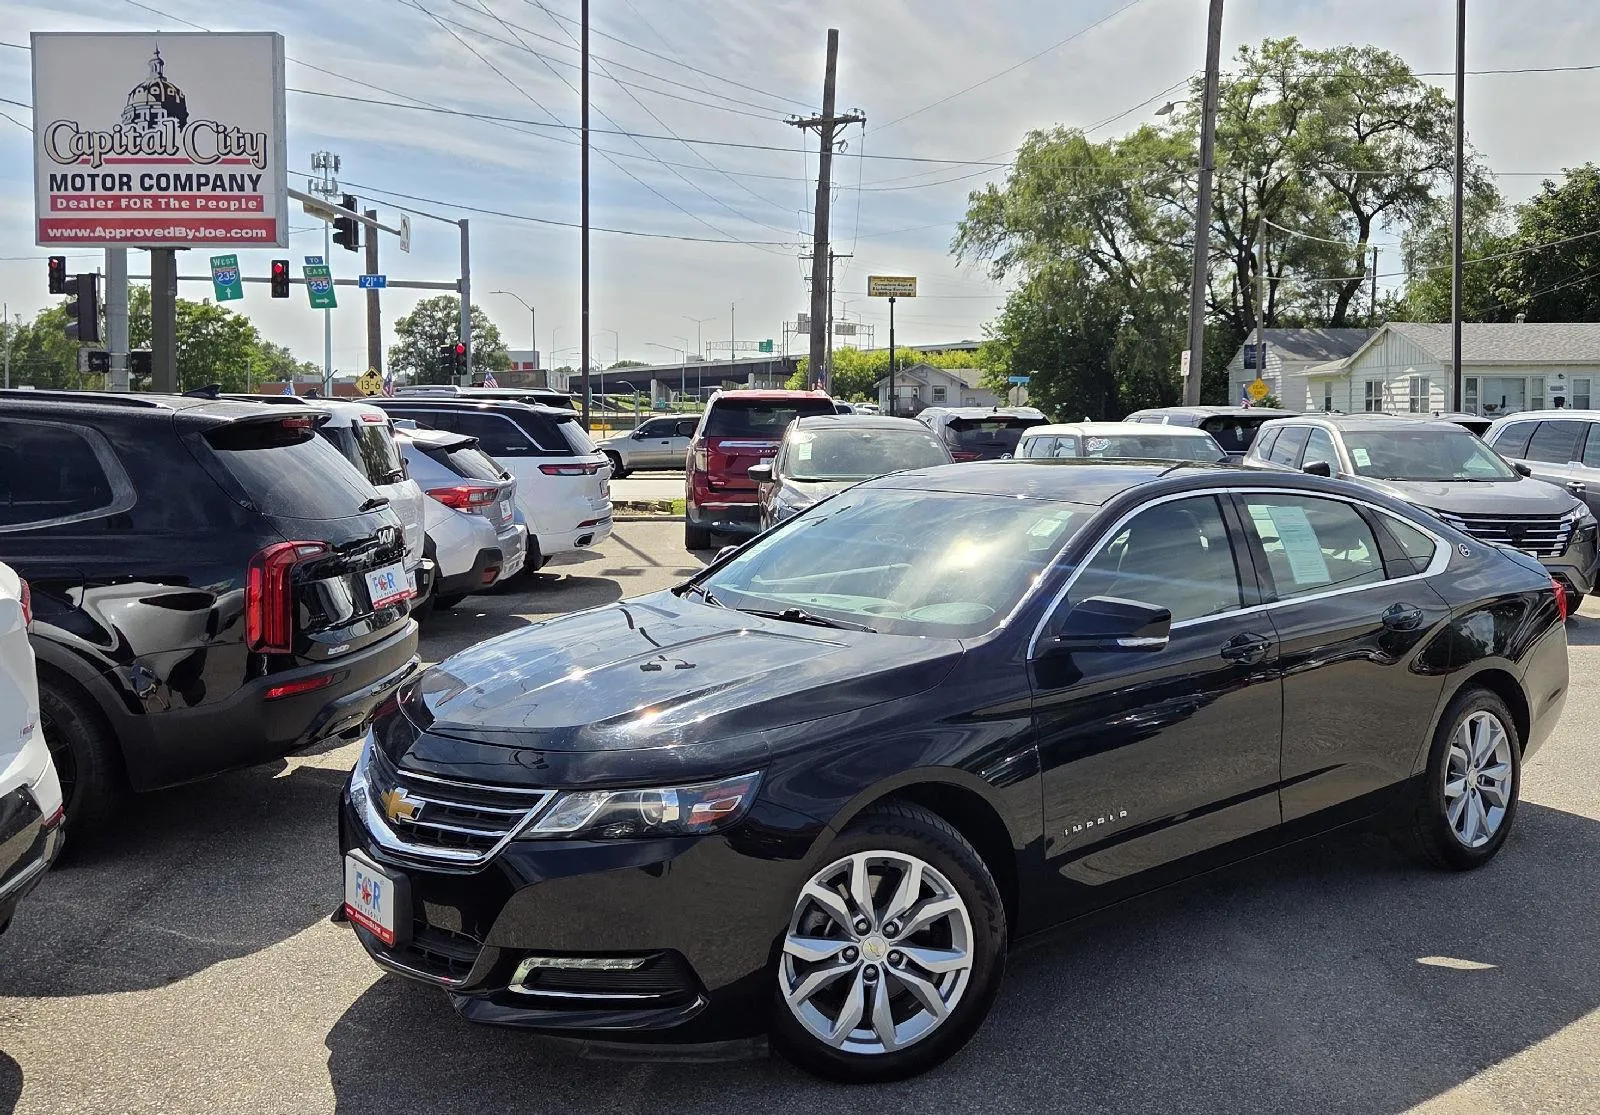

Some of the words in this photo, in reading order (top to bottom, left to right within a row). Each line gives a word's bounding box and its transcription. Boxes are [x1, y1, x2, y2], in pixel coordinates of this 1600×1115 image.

[44, 119, 179, 169] Capital
[183, 119, 268, 169] City
[49, 173, 132, 192] MOTOR
[139, 173, 262, 192] COMPANY
[56, 198, 114, 209] Dealer
[120, 198, 153, 209] FOR
[158, 198, 190, 209] The
[196, 198, 257, 212] People
[48, 226, 267, 239] www.ApprovedByJoe.com
[212, 257, 235, 266] WEST
[217, 271, 236, 281] 235
[310, 280, 329, 290] 235
[355, 870, 381, 913] FOR
